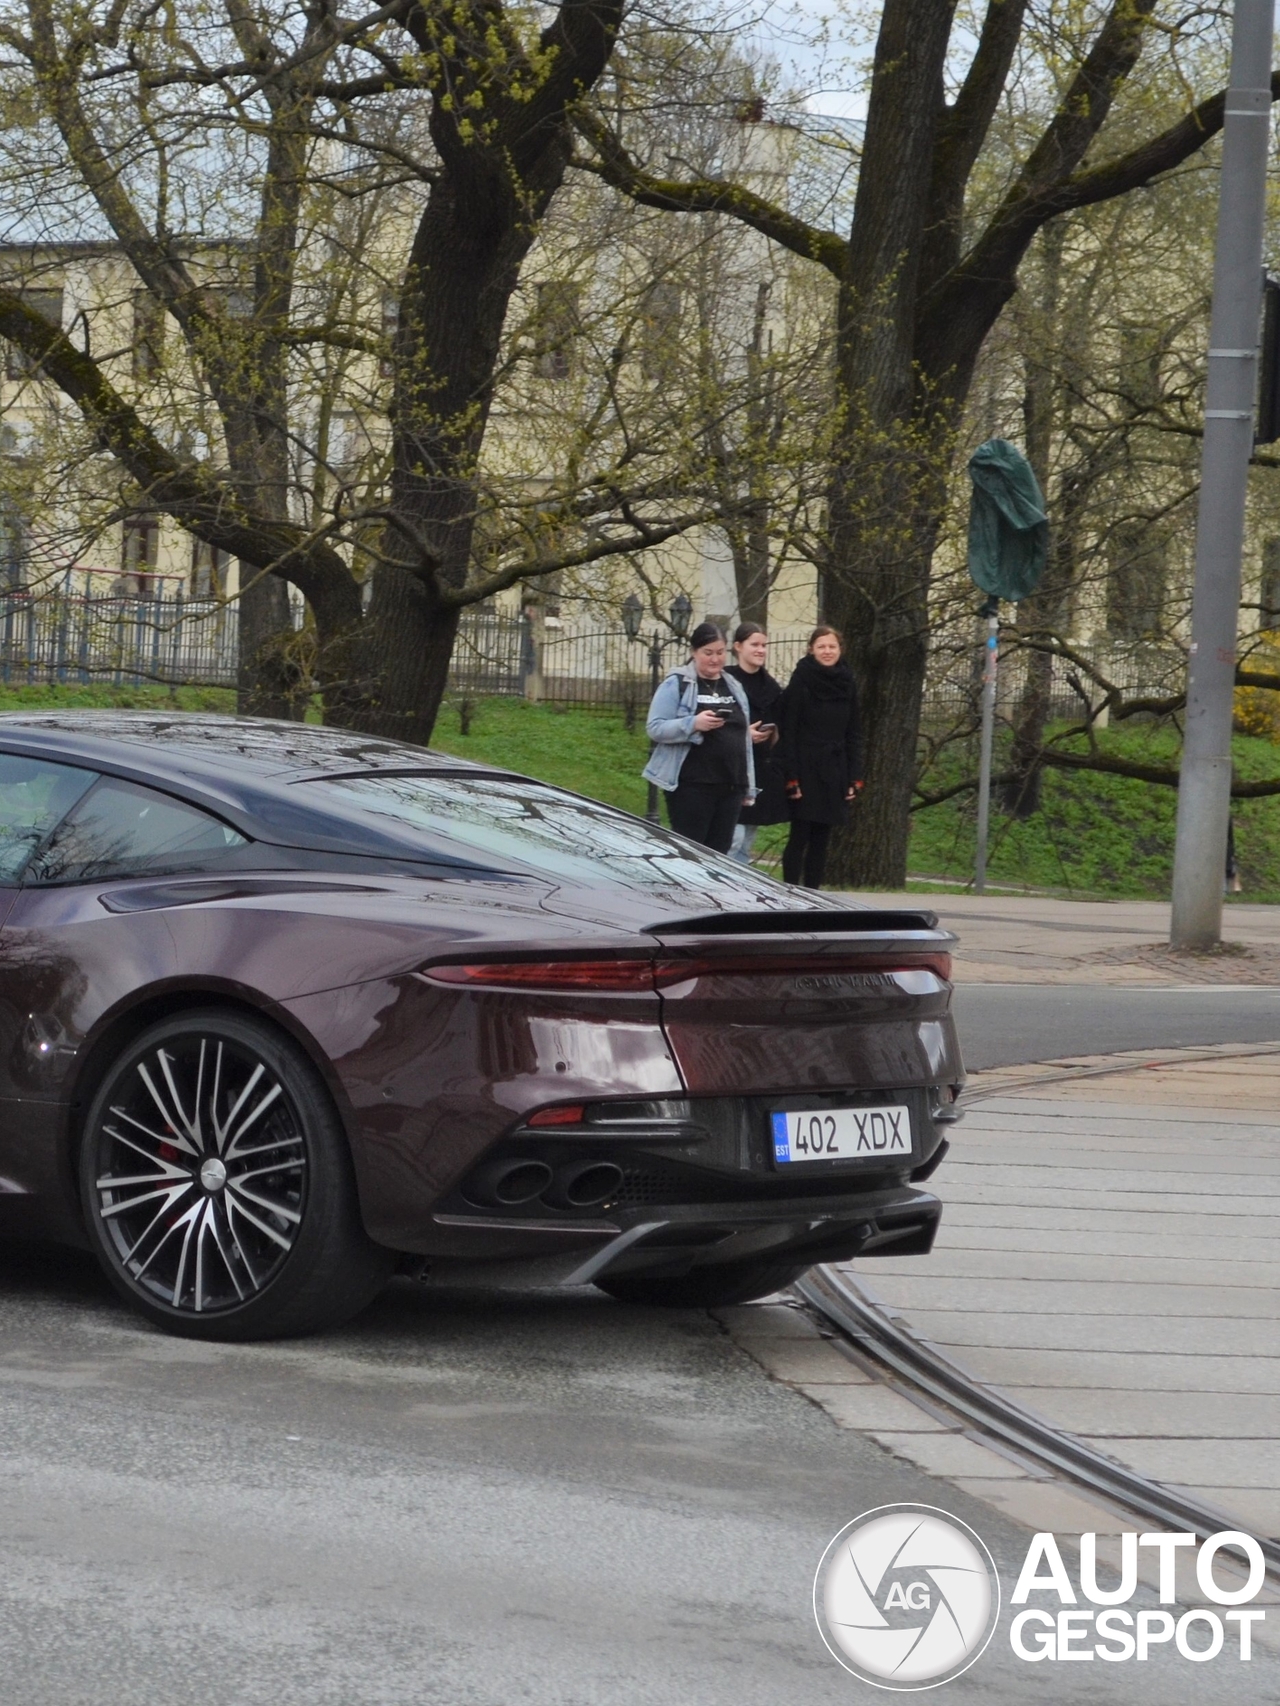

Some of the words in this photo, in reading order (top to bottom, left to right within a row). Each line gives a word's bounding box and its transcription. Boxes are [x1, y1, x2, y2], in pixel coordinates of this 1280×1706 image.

[795, 1115, 840, 1154] 402
[853, 1111, 905, 1151] XDX
[775, 1145, 789, 1157] EST
